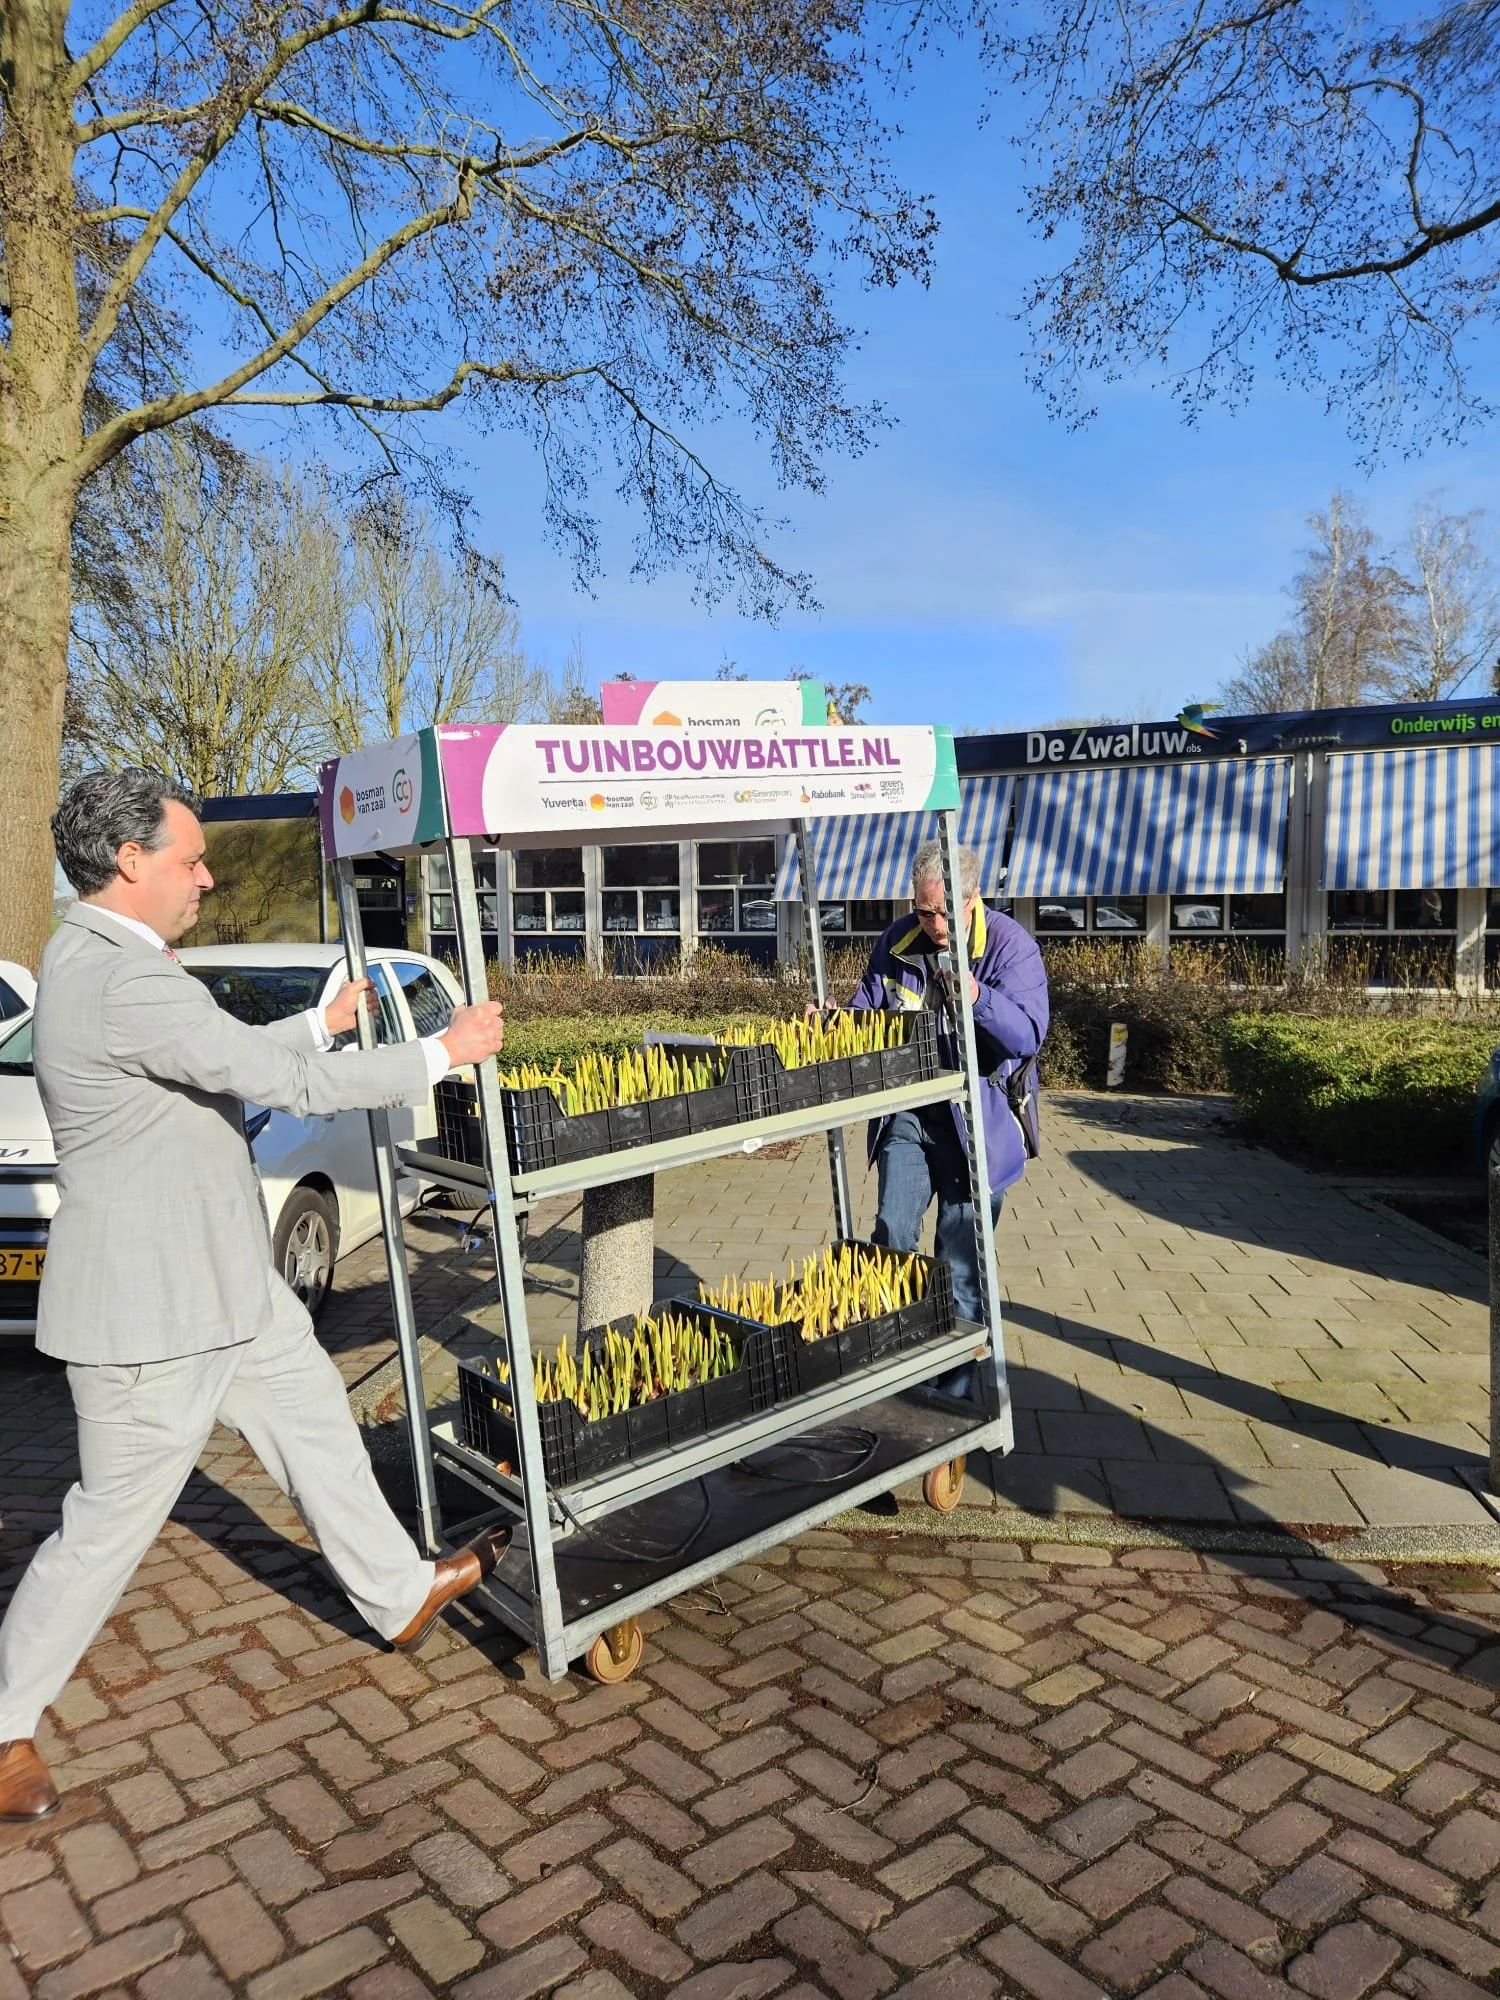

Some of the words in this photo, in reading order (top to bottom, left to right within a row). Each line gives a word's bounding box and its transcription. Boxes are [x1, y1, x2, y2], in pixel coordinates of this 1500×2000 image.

[1391, 713, 1476, 734] Onderwijs
[1481, 715, 1500, 729] en
[1026, 732, 1065, 764] De
[1069, 724, 1189, 761] Zwaluw
[1186, 743, 1202, 753] obs
[535, 738, 900, 774] TUINBOUWBATTLE.NL
[355, 786, 385, 802] bosman
[811, 788, 846, 799] Rabobank
[357, 804, 370, 814] van
[371, 797, 386, 811] zaal
[541, 797, 584, 809] Yuverta
